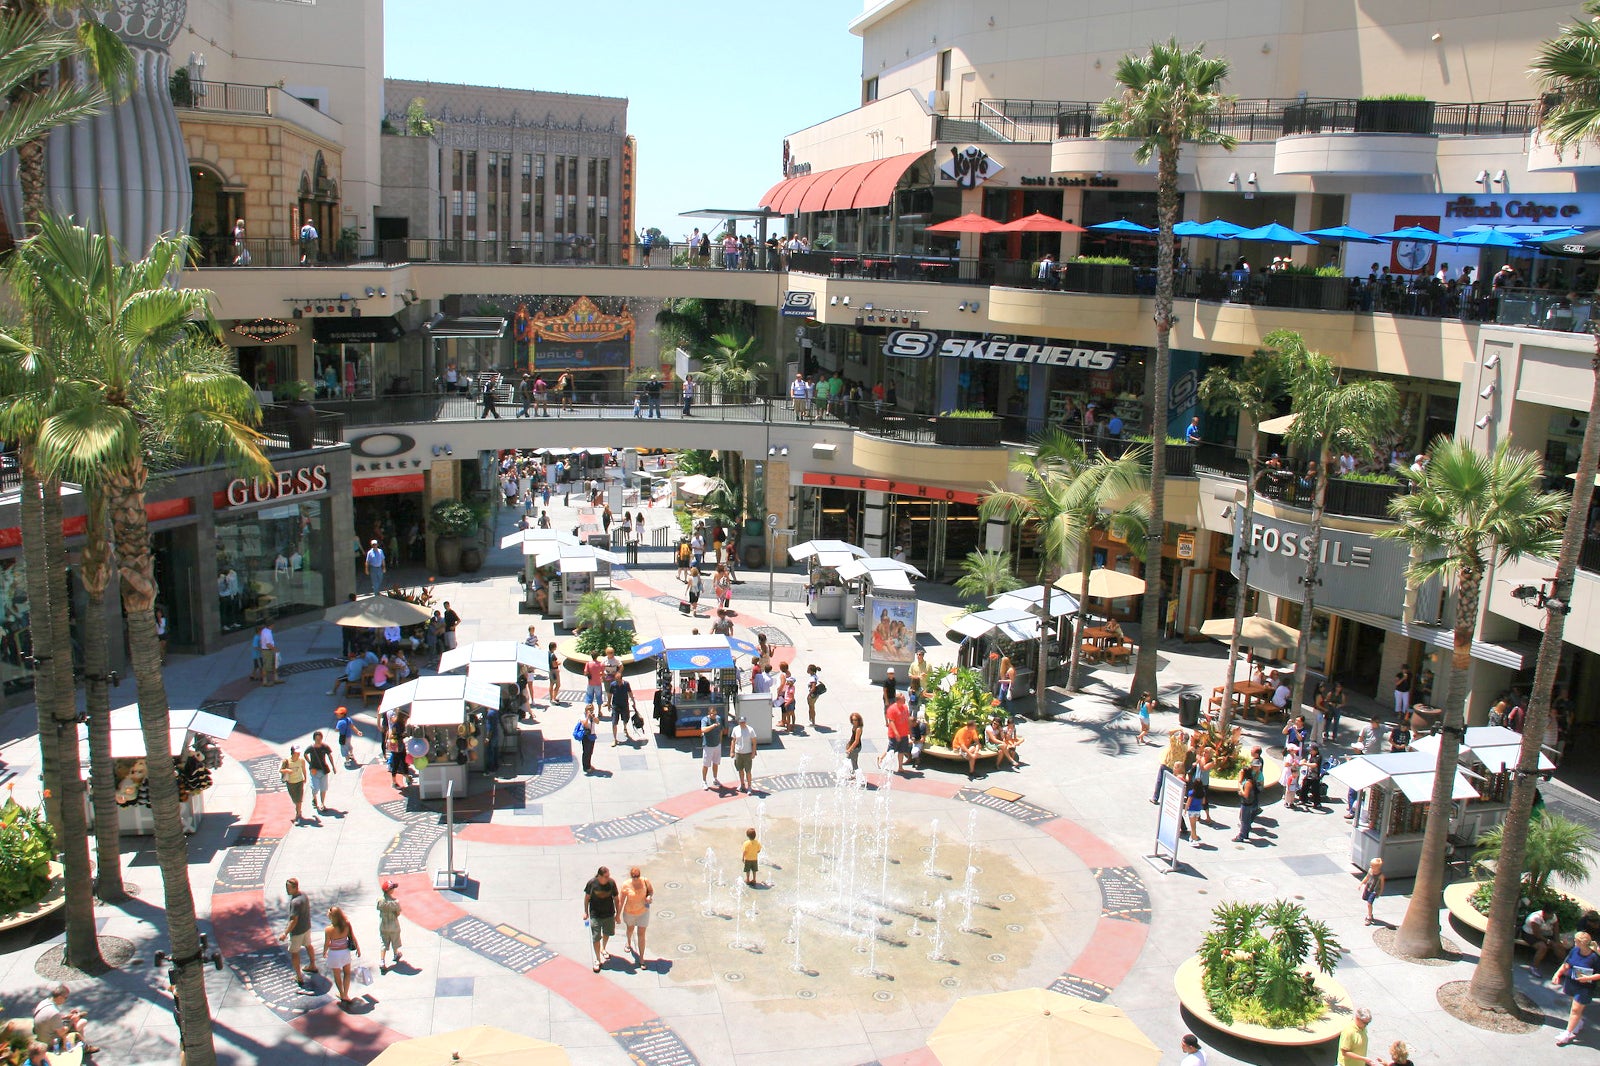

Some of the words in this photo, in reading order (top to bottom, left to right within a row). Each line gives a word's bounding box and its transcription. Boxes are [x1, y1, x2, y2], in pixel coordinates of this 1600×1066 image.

[1057, 177, 1087, 187] Shabu
[1445, 200, 1503, 218] French
[553, 324, 566, 332] EL
[568, 323, 615, 332] CAPITAN
[939, 338, 1118, 370] SKECHERS
[355, 460, 422, 472] AKLEY
[227, 464, 328, 507] GUESS
[829, 475, 987, 506] SEPHOR
